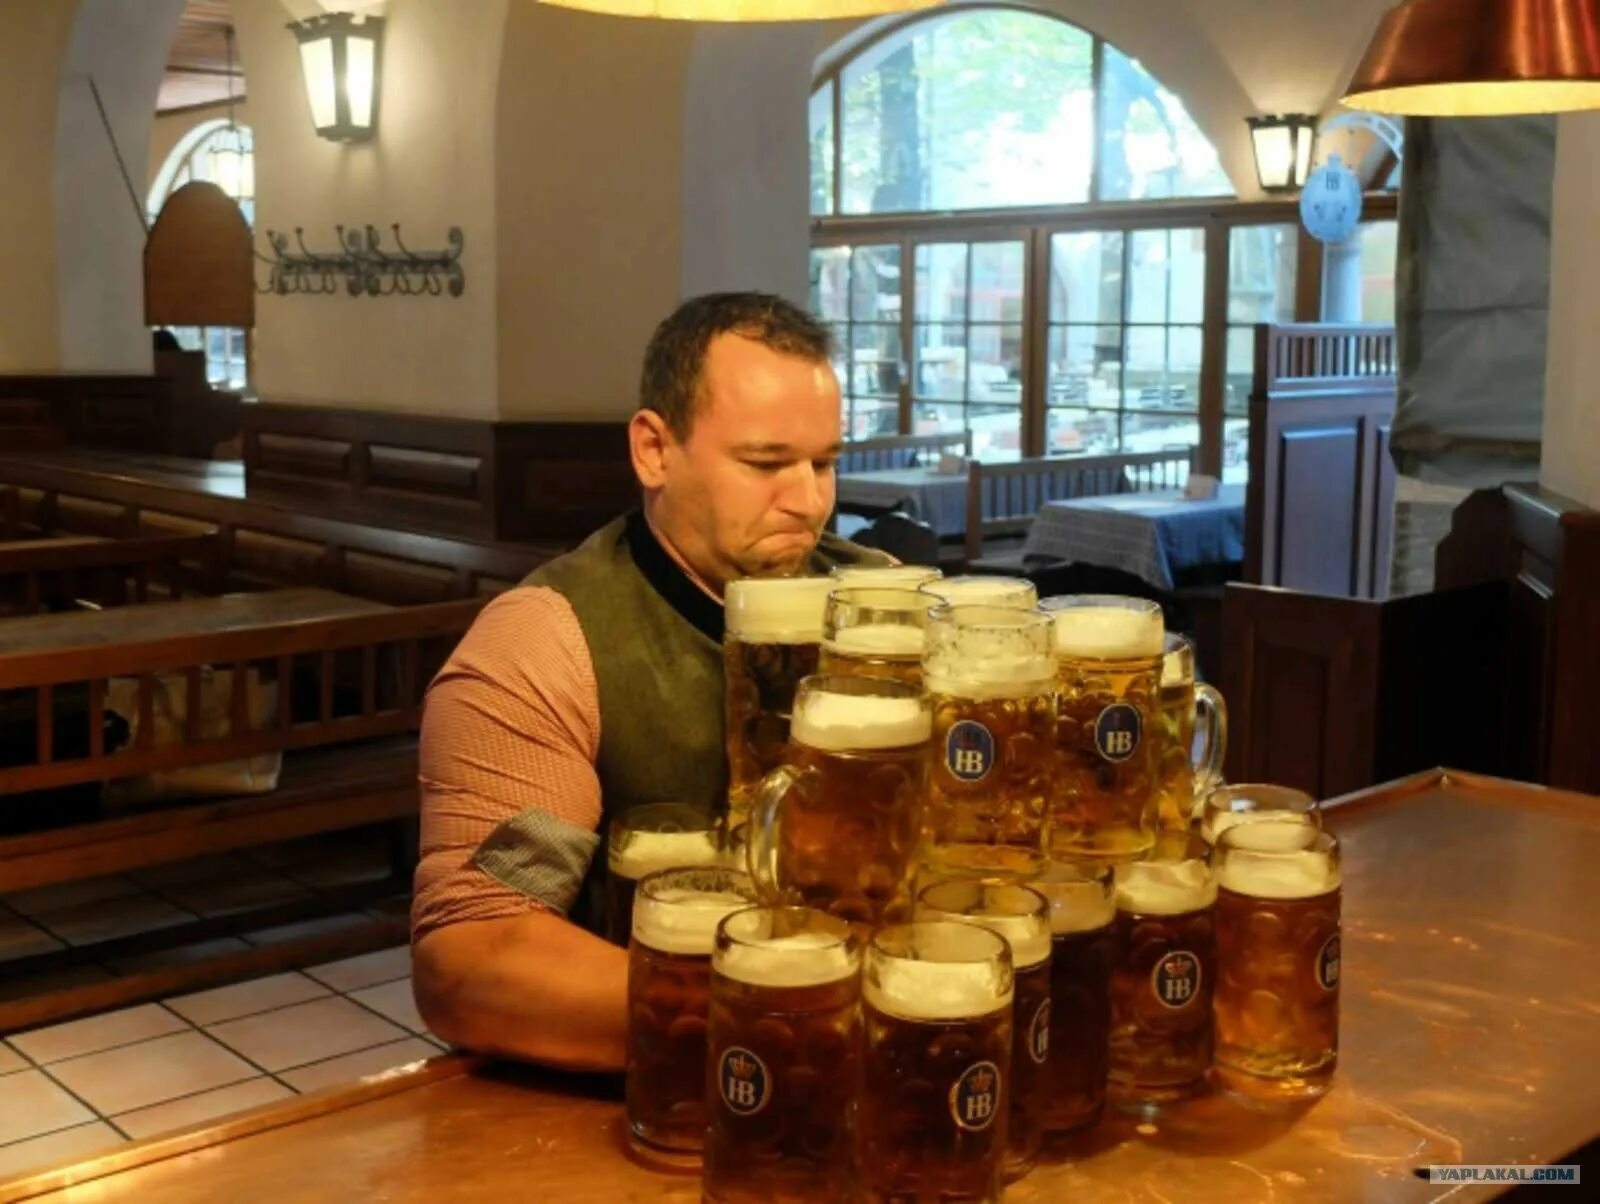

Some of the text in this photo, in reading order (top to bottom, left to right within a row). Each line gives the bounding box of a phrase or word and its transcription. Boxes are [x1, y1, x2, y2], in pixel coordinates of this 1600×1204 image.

[1106, 731, 1132, 754] HB
[955, 748, 984, 773] HB
[1165, 978, 1191, 1000] HB
[728, 1076, 756, 1106] HB
[966, 1092, 992, 1121] HB
